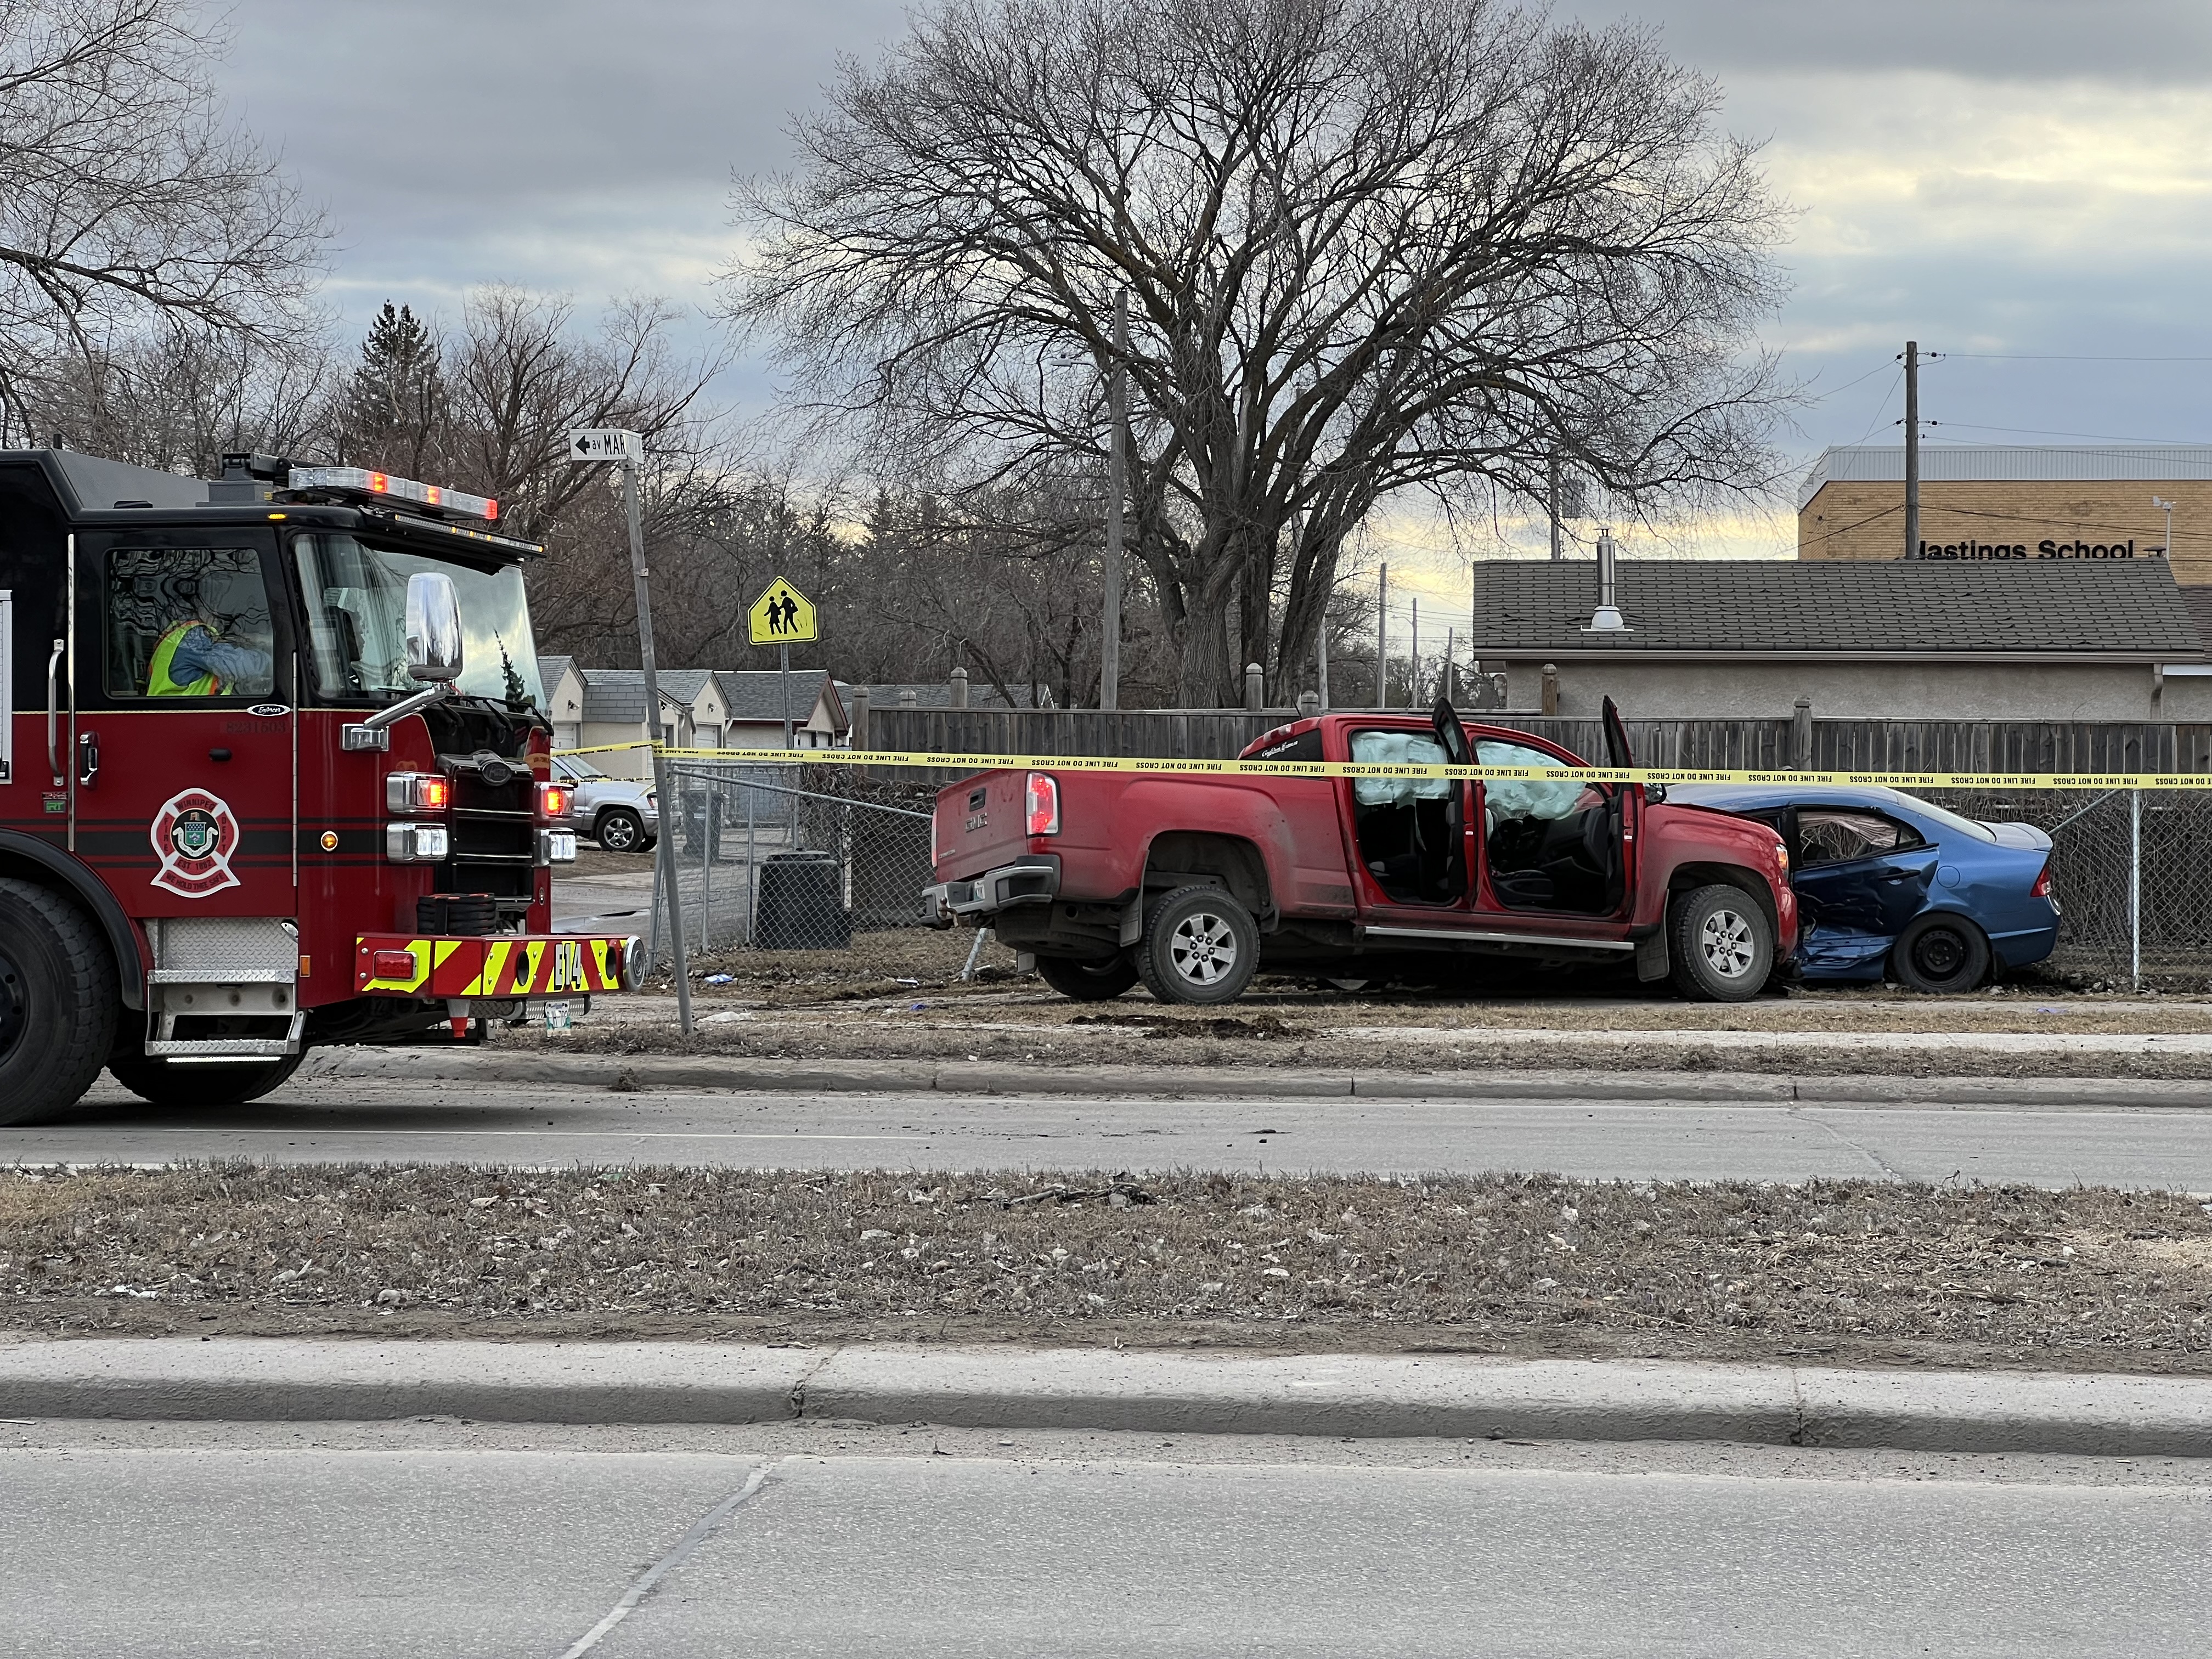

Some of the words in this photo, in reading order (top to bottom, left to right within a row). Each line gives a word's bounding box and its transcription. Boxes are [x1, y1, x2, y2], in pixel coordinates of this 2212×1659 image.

[592, 439, 601, 450] av
[2038, 539, 2134, 558] School
[176, 799, 214, 811] WINNIPEG
[965, 812, 988, 832] GMC
[177, 860, 190, 870] EST
[166, 872, 176, 882] WE
[209, 872, 224, 884] SAFE
[554, 943, 582, 991] E14
